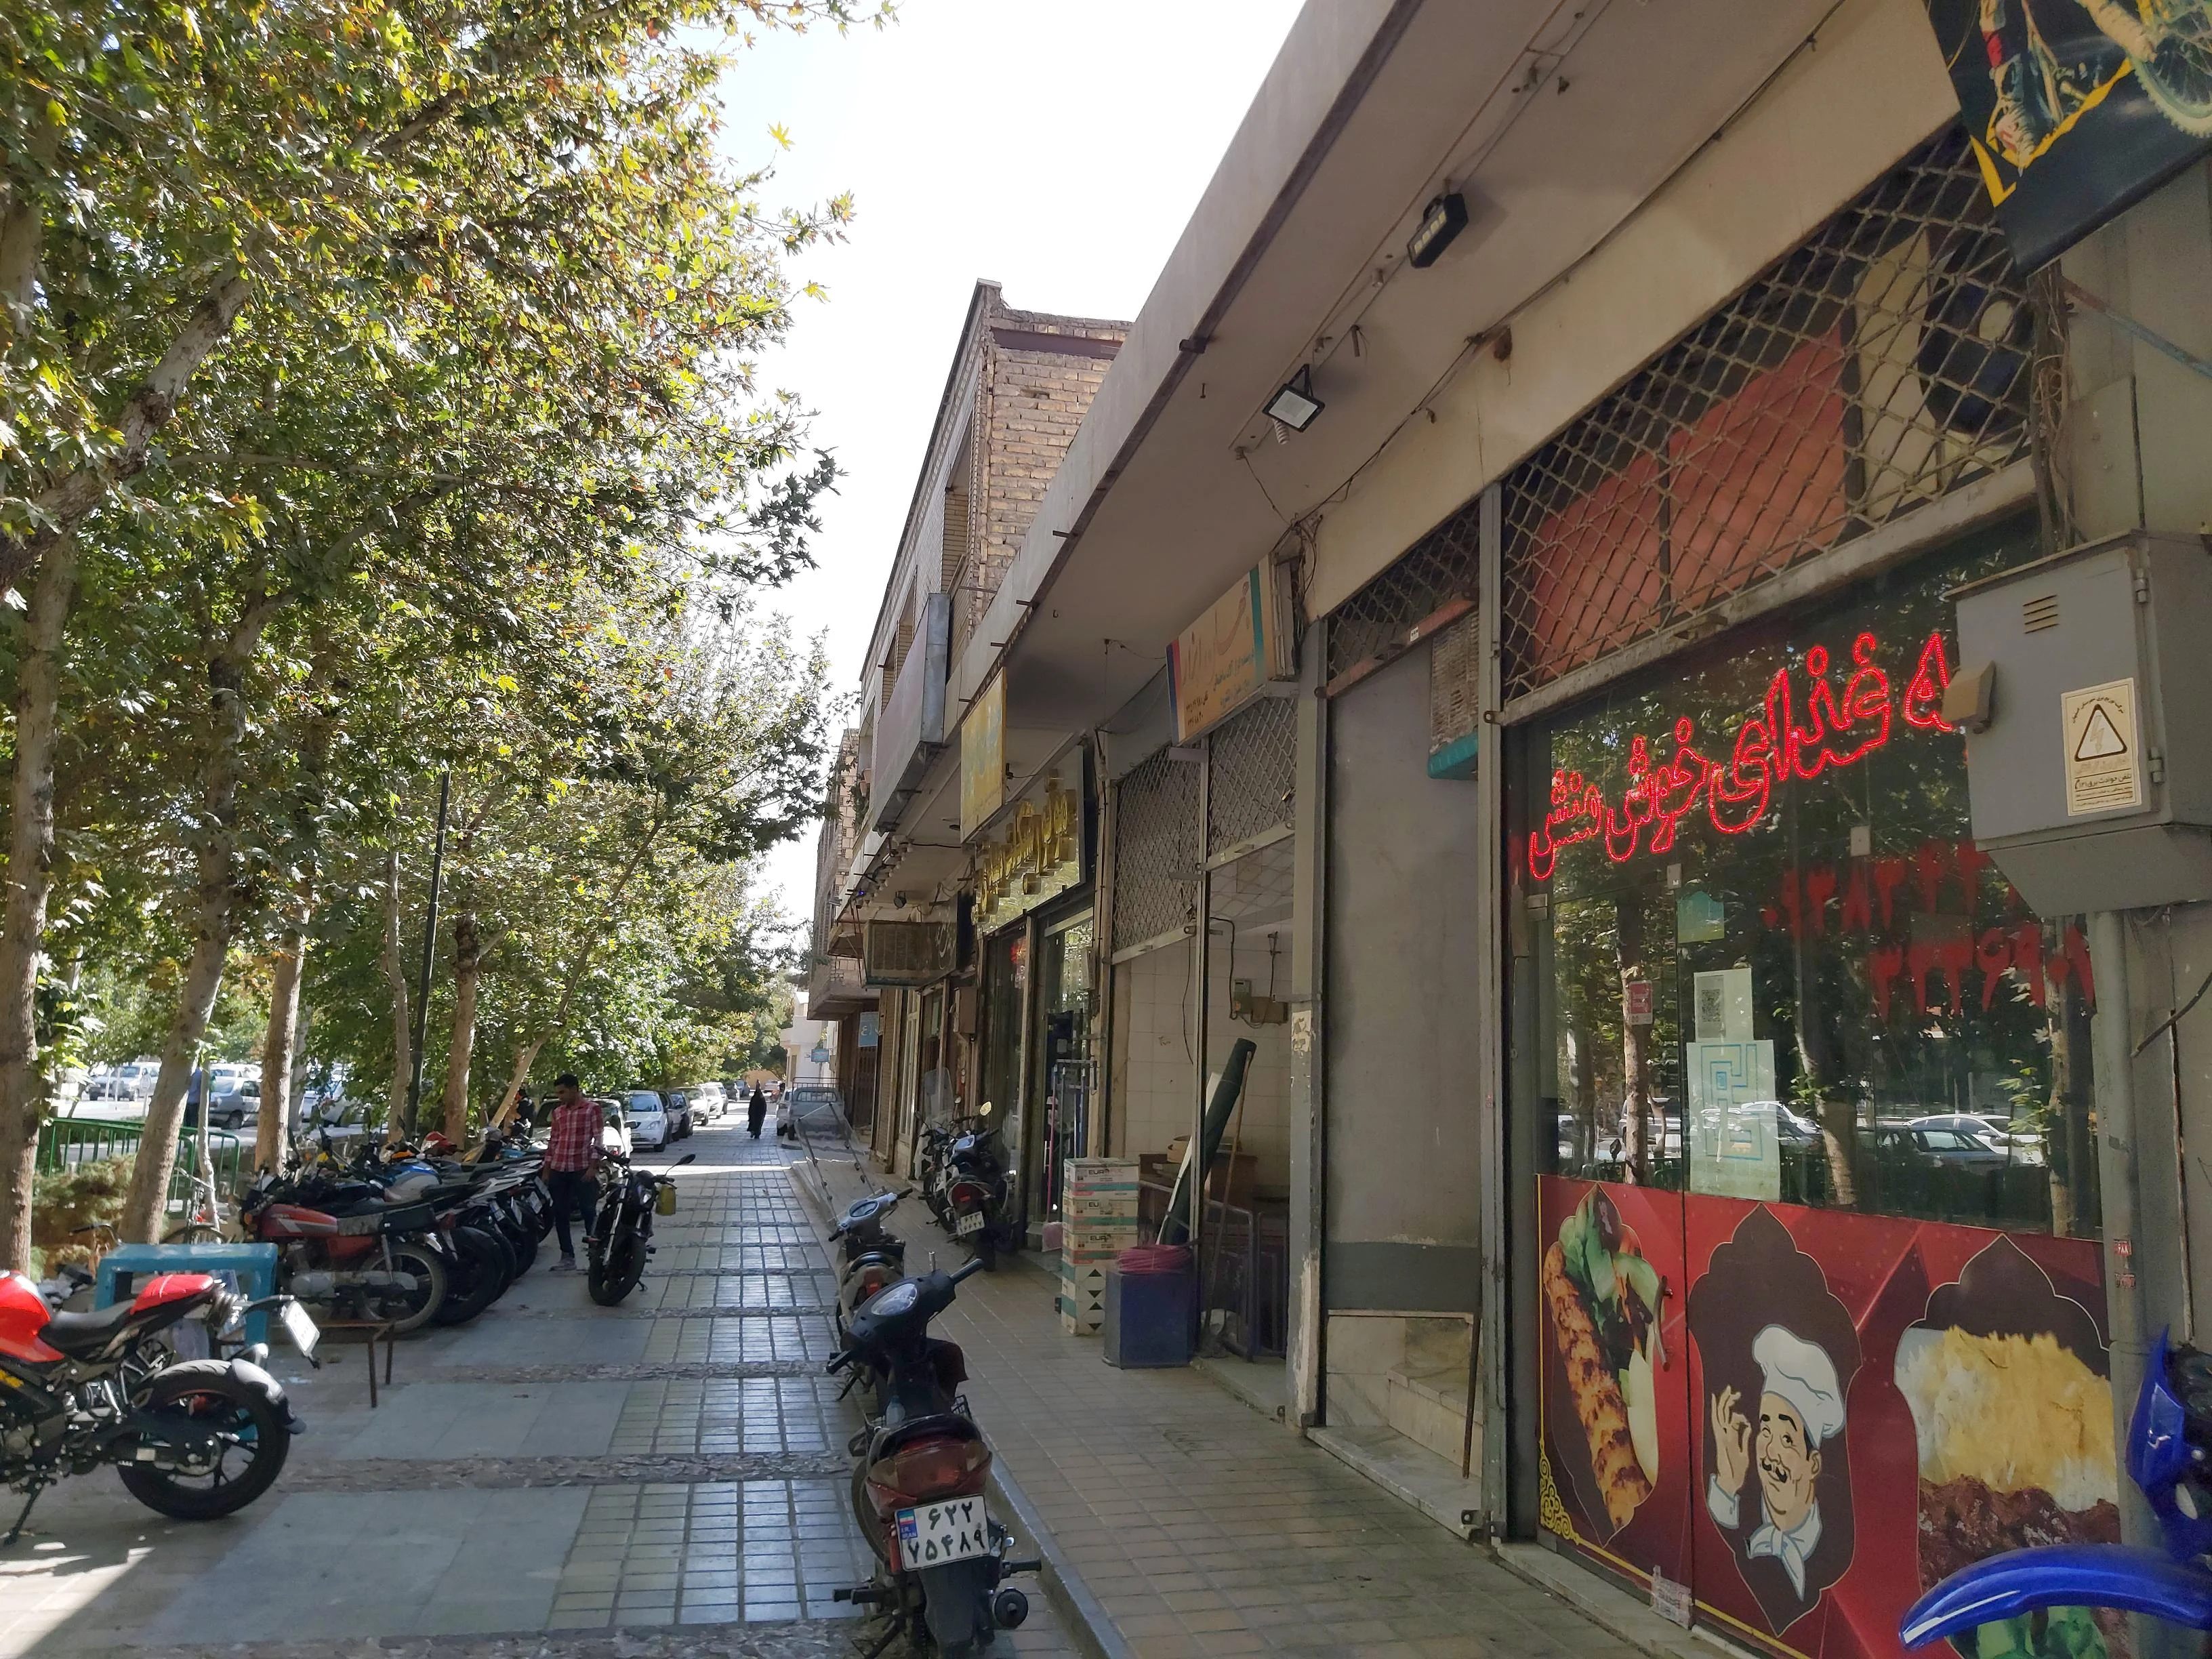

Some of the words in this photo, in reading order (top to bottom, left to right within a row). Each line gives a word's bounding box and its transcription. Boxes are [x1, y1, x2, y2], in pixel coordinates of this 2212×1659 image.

[1605, 715, 1708, 863] خوش
[1708, 631, 1892, 834] غذای
[1529, 768, 1603, 881] منش
[907, 1529, 985, 1563] ۷۵۴۸۹
[928, 1501, 972, 1530] ۶۲۲
